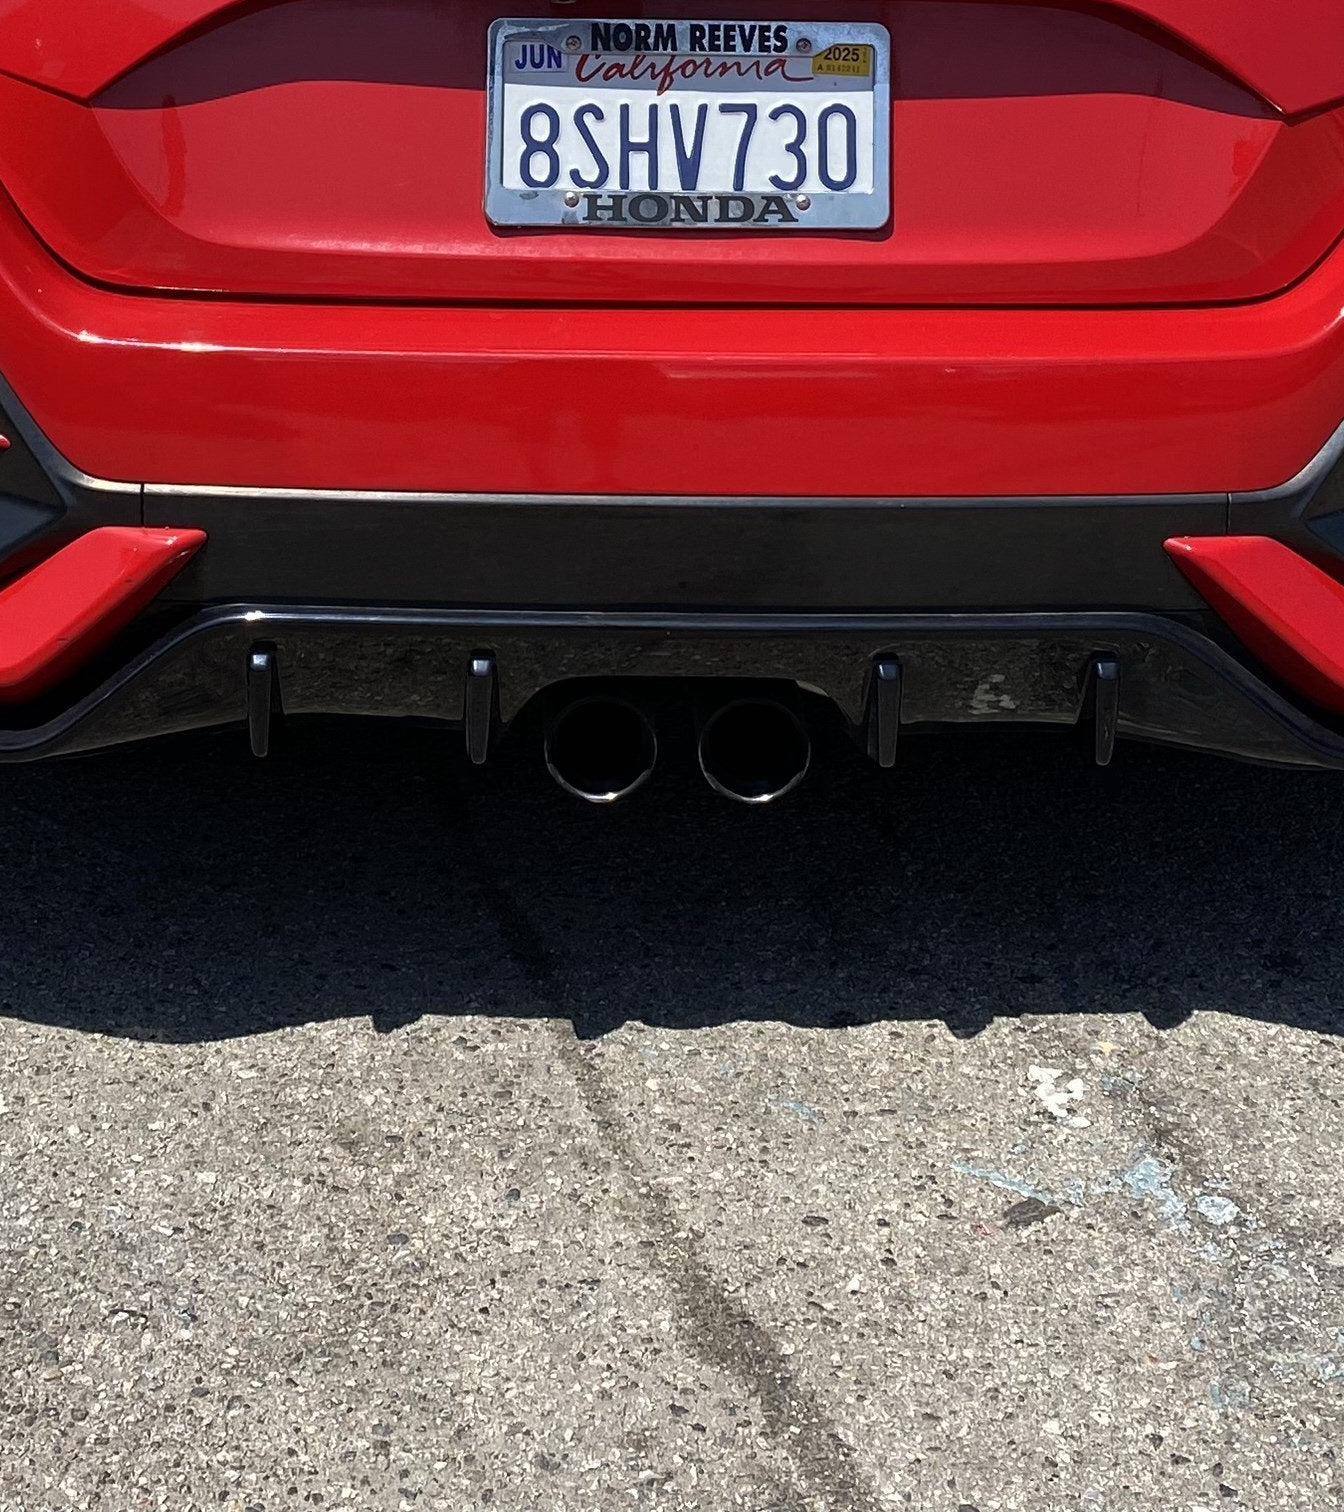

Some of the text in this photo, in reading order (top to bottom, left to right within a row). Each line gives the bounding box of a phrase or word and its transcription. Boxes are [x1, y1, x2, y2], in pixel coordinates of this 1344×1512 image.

[590, 22, 788, 53] NORM REEVES
[514, 44, 563, 70] JUN
[824, 46, 861, 63] 2025
[575, 53, 815, 97] California
[518, 102, 857, 191] 8SHV730
[581, 193, 799, 224] HONDA
